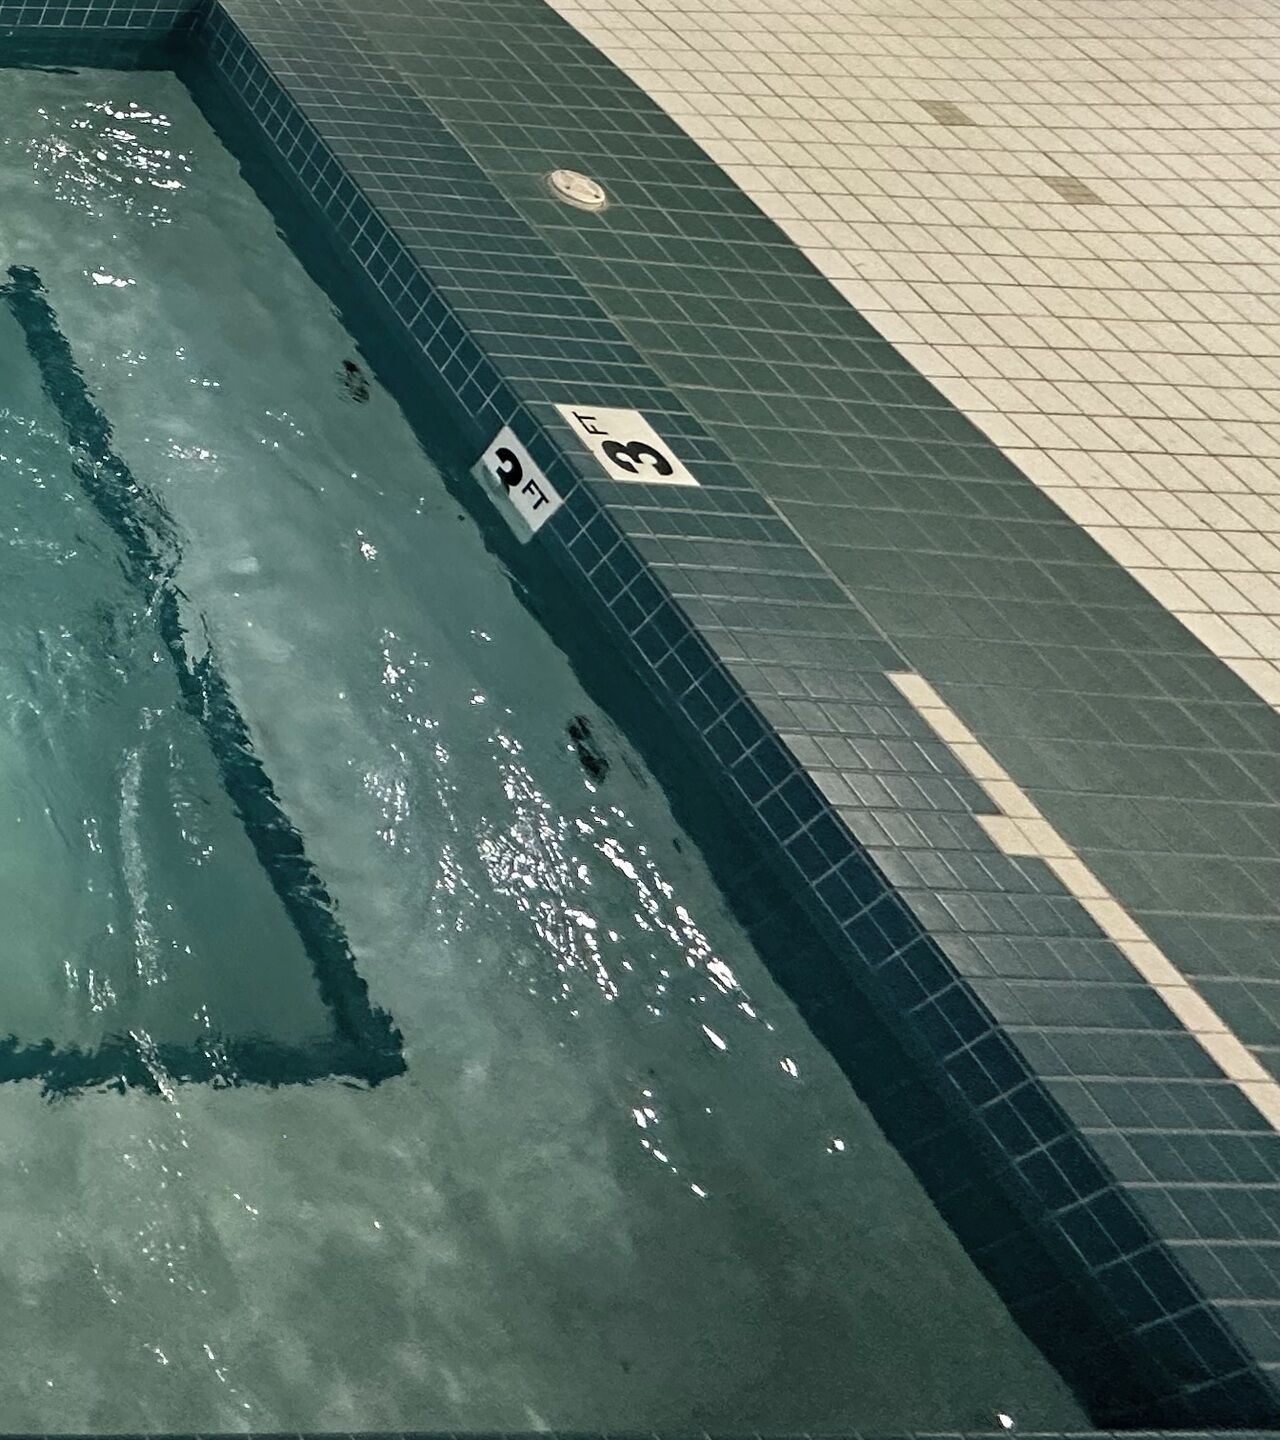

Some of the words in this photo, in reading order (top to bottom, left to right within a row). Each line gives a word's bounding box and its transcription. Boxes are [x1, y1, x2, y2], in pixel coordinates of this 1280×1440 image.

[572, 411, 609, 435] FT
[601, 440, 674, 476] 3
[521, 478, 550, 510] FT
